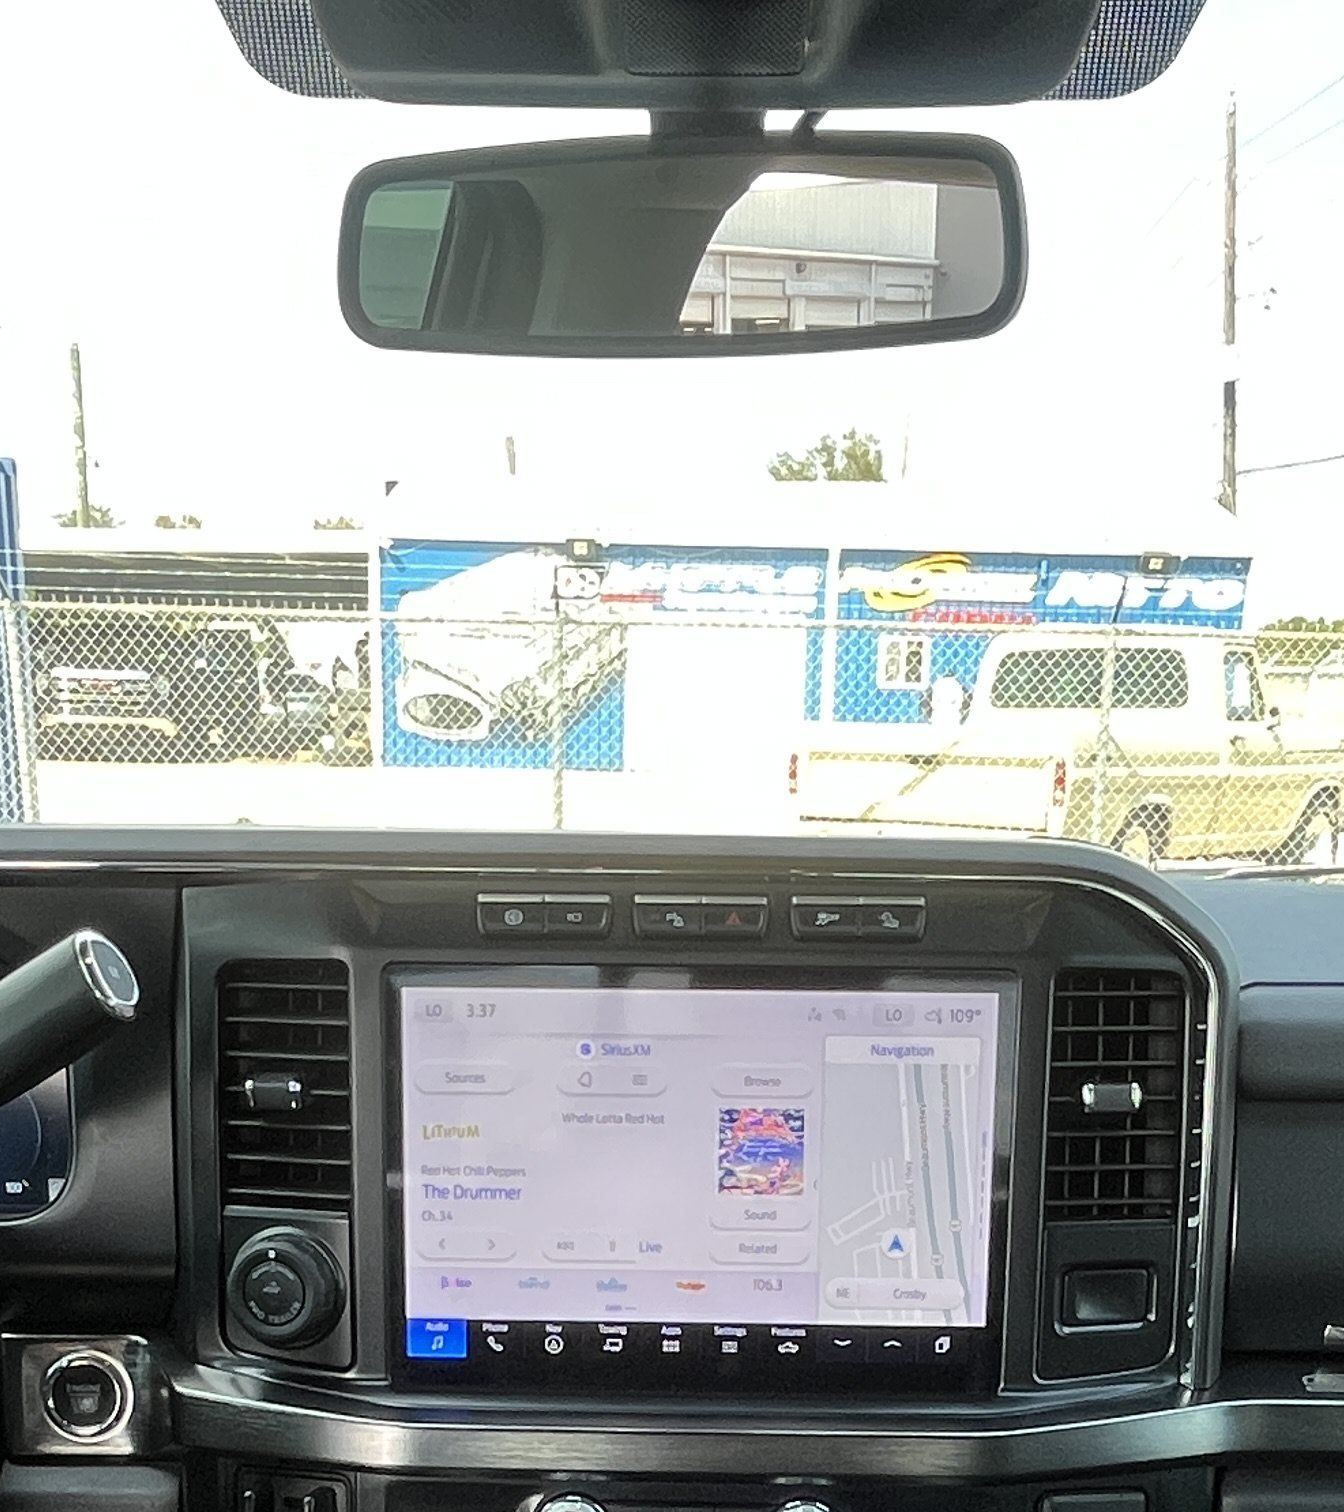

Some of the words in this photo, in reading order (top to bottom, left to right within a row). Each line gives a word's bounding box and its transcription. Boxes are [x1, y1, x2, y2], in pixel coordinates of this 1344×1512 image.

[884, 1008, 903, 1023] LO
[869, 1043, 935, 1059] Navigation
[444, 1071, 486, 1084] Sources
[561, 1112, 594, 1125] Whole
[624, 1113, 644, 1125] Red
[421, 1183, 451, 1201] The
[452, 1184, 522, 1201] Drummer
[638, 1241, 663, 1254] Live
